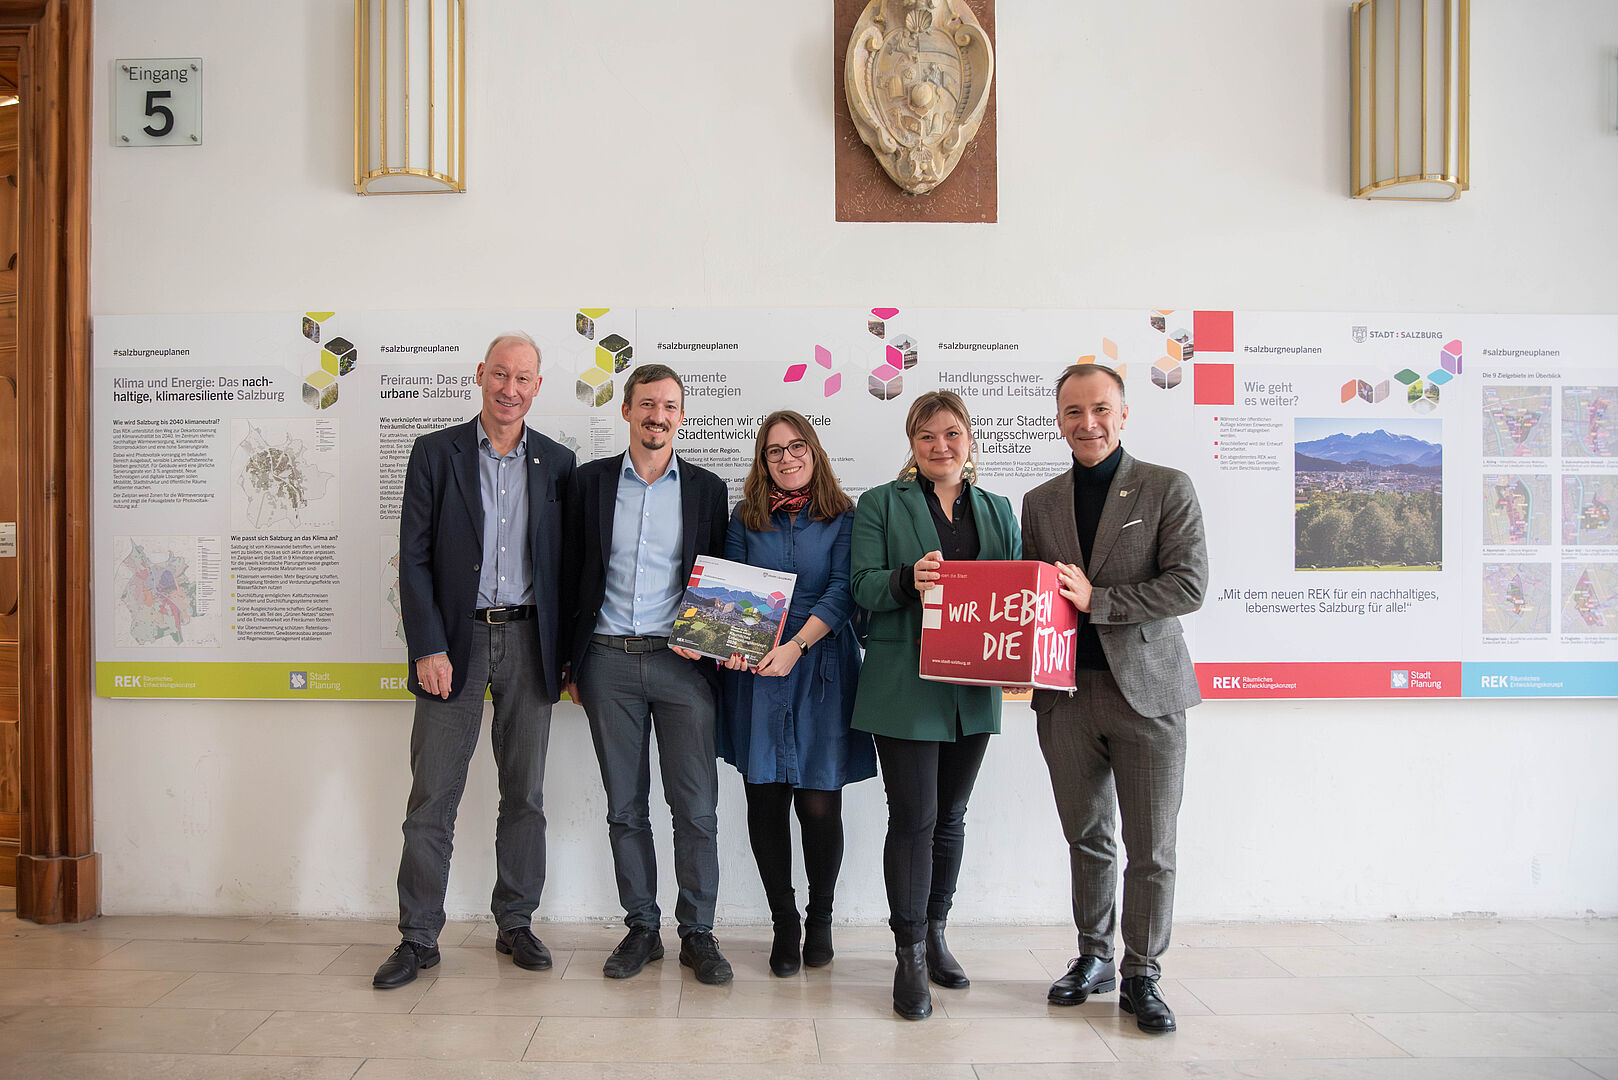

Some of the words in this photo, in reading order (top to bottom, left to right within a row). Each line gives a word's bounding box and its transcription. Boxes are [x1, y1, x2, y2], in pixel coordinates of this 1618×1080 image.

[130, 66, 188, 83] Eingang
[143, 90, 174, 137] 5
[380, 344, 460, 354] #salzburgneuplanen
[657, 342, 739, 351] #salzburgneuplanen
[938, 342, 1019, 351] #salzburgneuplanen
[1244, 345, 1322, 354] #salzburgneuplanen
[113, 348, 190, 357] #salzburgneuplanen
[1482, 348, 1560, 357] #salzburgneuplanen
[380, 374, 433, 385] Freiraum:
[437, 374, 458, 384] Das
[679, 372, 727, 382] rumente
[939, 372, 1044, 384] Handlungsschwer-
[114, 378, 144, 388] Klima
[148, 377, 168, 388] und
[172, 377, 214, 390] Energie:
[219, 377, 239, 387] Das
[242, 376, 273, 386] nach-
[1244, 381, 1265, 392] Wie
[1268, 382, 1292, 395] geht
[114, 391, 152, 402] haltige,
[156, 390, 234, 401] klimaresiliente
[238, 390, 284, 402] Salzburg
[380, 388, 419, 398] urbane
[422, 388, 471, 400] Salzburg
[684, 385, 741, 398] Strategien
[982, 386, 1003, 396] und
[1008, 386, 1057, 396] Leitsätze
[1260, 395, 1298, 406] weiter?
[682, 415, 734, 426] erreichen
[737, 415, 754, 426] wir
[971, 415, 993, 426] sion
[996, 418, 1014, 426] zur
[982, 443, 1031, 453] Leitsätze
[1218, 589, 1240, 601] „Mit
[1244, 589, 1268, 599] dem
[1308, 589, 1330, 599] REK
[1334, 588, 1346, 599] für
[1351, 589, 1366, 599] ein
[1370, 589, 1438, 601] nachhaltiges,
[948, 601, 980, 623] WIR
[989, 589, 1053, 626] LEBEN
[1246, 602, 1316, 613] lebenswertes
[1319, 602, 1365, 615] Salzburg
[1368, 602, 1381, 612] für
[982, 631, 1023, 660] DIE
[1034, 626, 1076, 675] STADT
[310, 672, 330, 680] Stadt
[1411, 671, 1431, 679] Stadt
[115, 675, 141, 687] REK
[310, 681, 341, 691] Planung
[381, 678, 407, 689] REK
[1213, 677, 1240, 688] REK
[1411, 680, 1441, 689] Planung
[1481, 676, 1508, 688] REK
